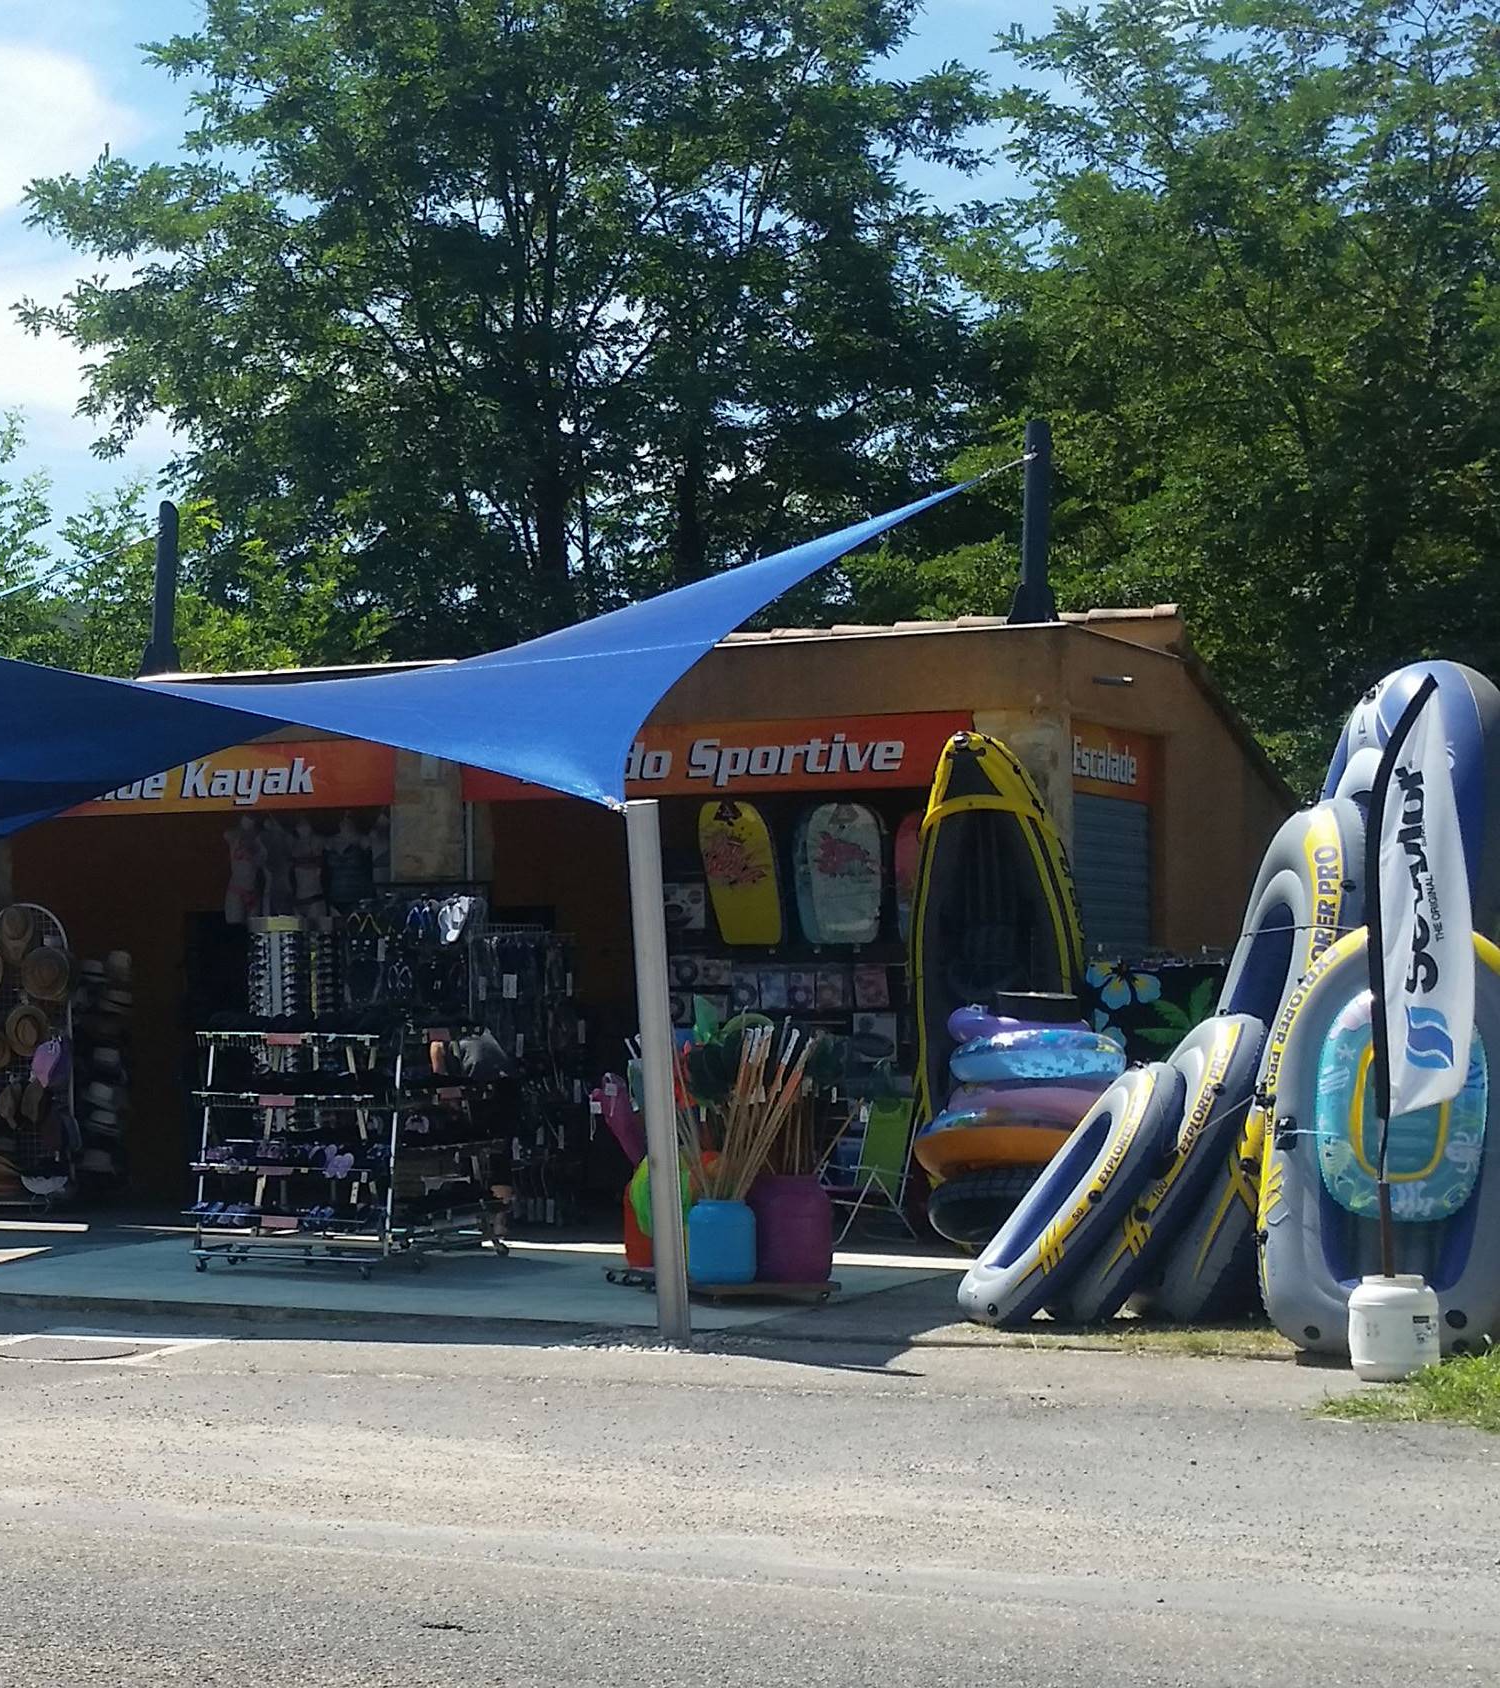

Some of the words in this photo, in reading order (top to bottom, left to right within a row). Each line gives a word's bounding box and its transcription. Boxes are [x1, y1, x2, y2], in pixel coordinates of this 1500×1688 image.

[181, 757, 315, 805] Kayak
[626, 741, 673, 781] do
[688, 733, 904, 787] Sportive
[1073, 735, 1138, 785] Escalade
[1314, 846, 1338, 895] PRO
[1425, 875, 1441, 921] ORIGINAL
[1311, 899, 1336, 962] ORER
[1434, 922, 1445, 942] THE
[1267, 1050, 1282, 1088] PRO
[1072, 1207, 1084, 1222] 50
